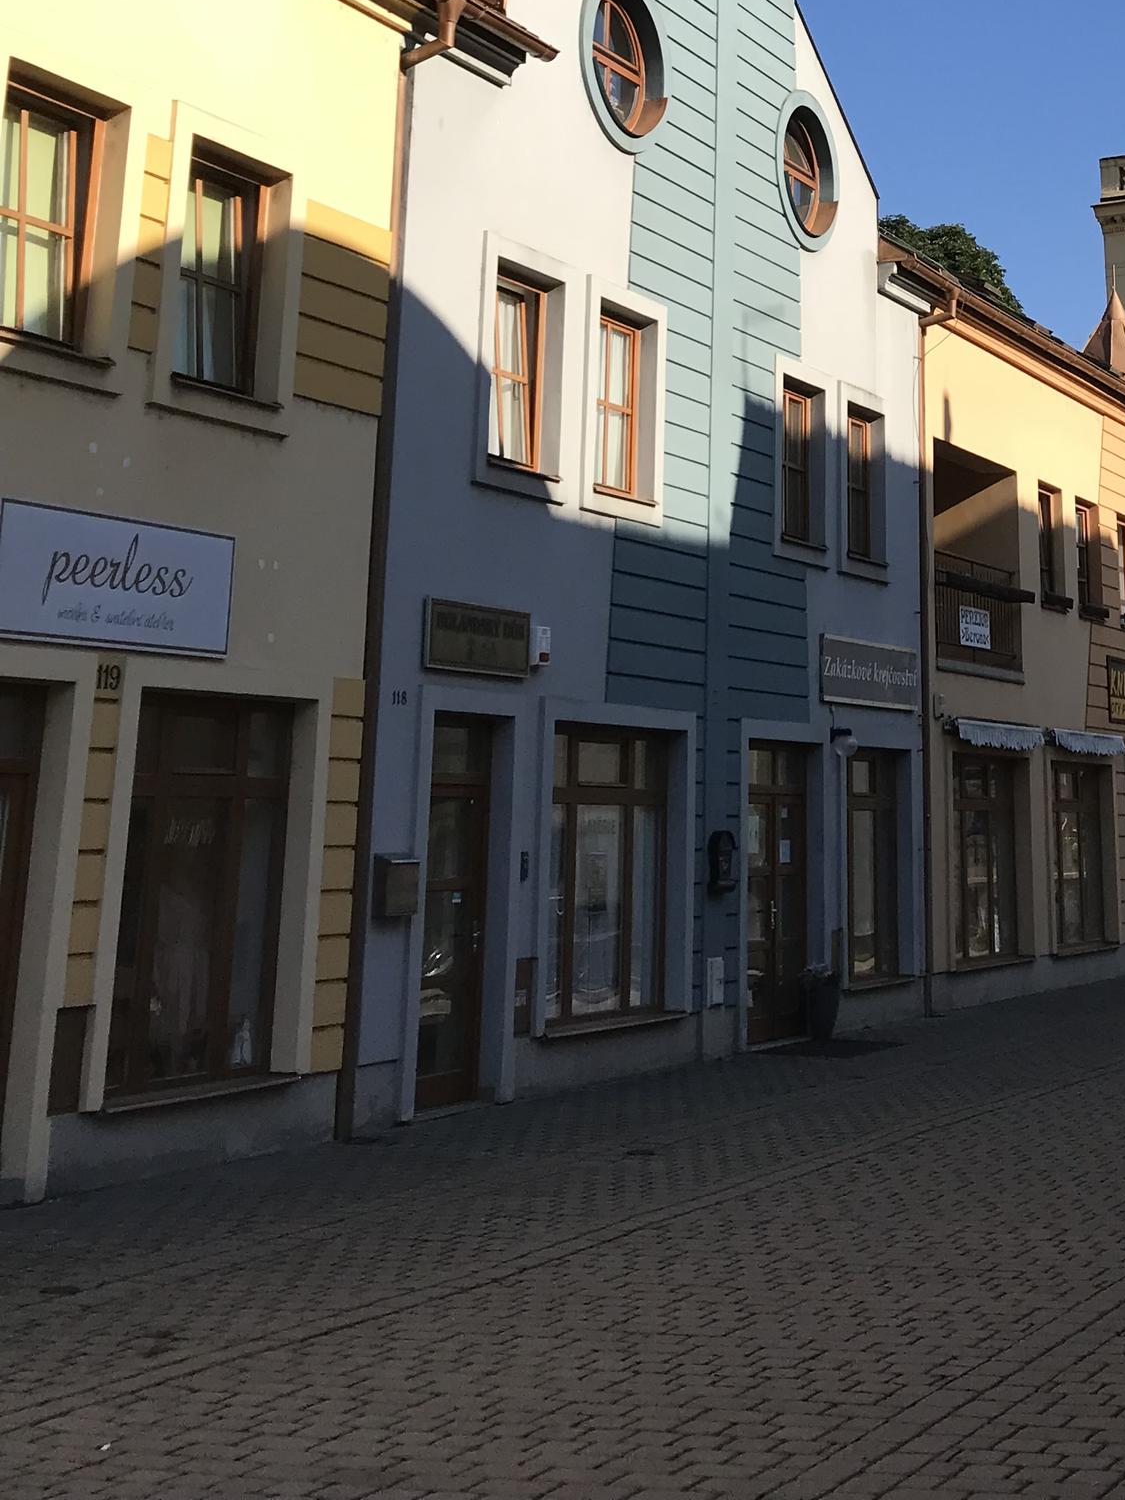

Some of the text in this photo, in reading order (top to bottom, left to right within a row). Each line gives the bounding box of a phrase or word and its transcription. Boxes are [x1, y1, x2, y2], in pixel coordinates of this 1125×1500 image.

[41, 533, 194, 606] peerless
[96, 664, 121, 691] 119
[823, 656, 918, 690] Zakázkové krejčovství
[392, 690, 407, 706] 118
